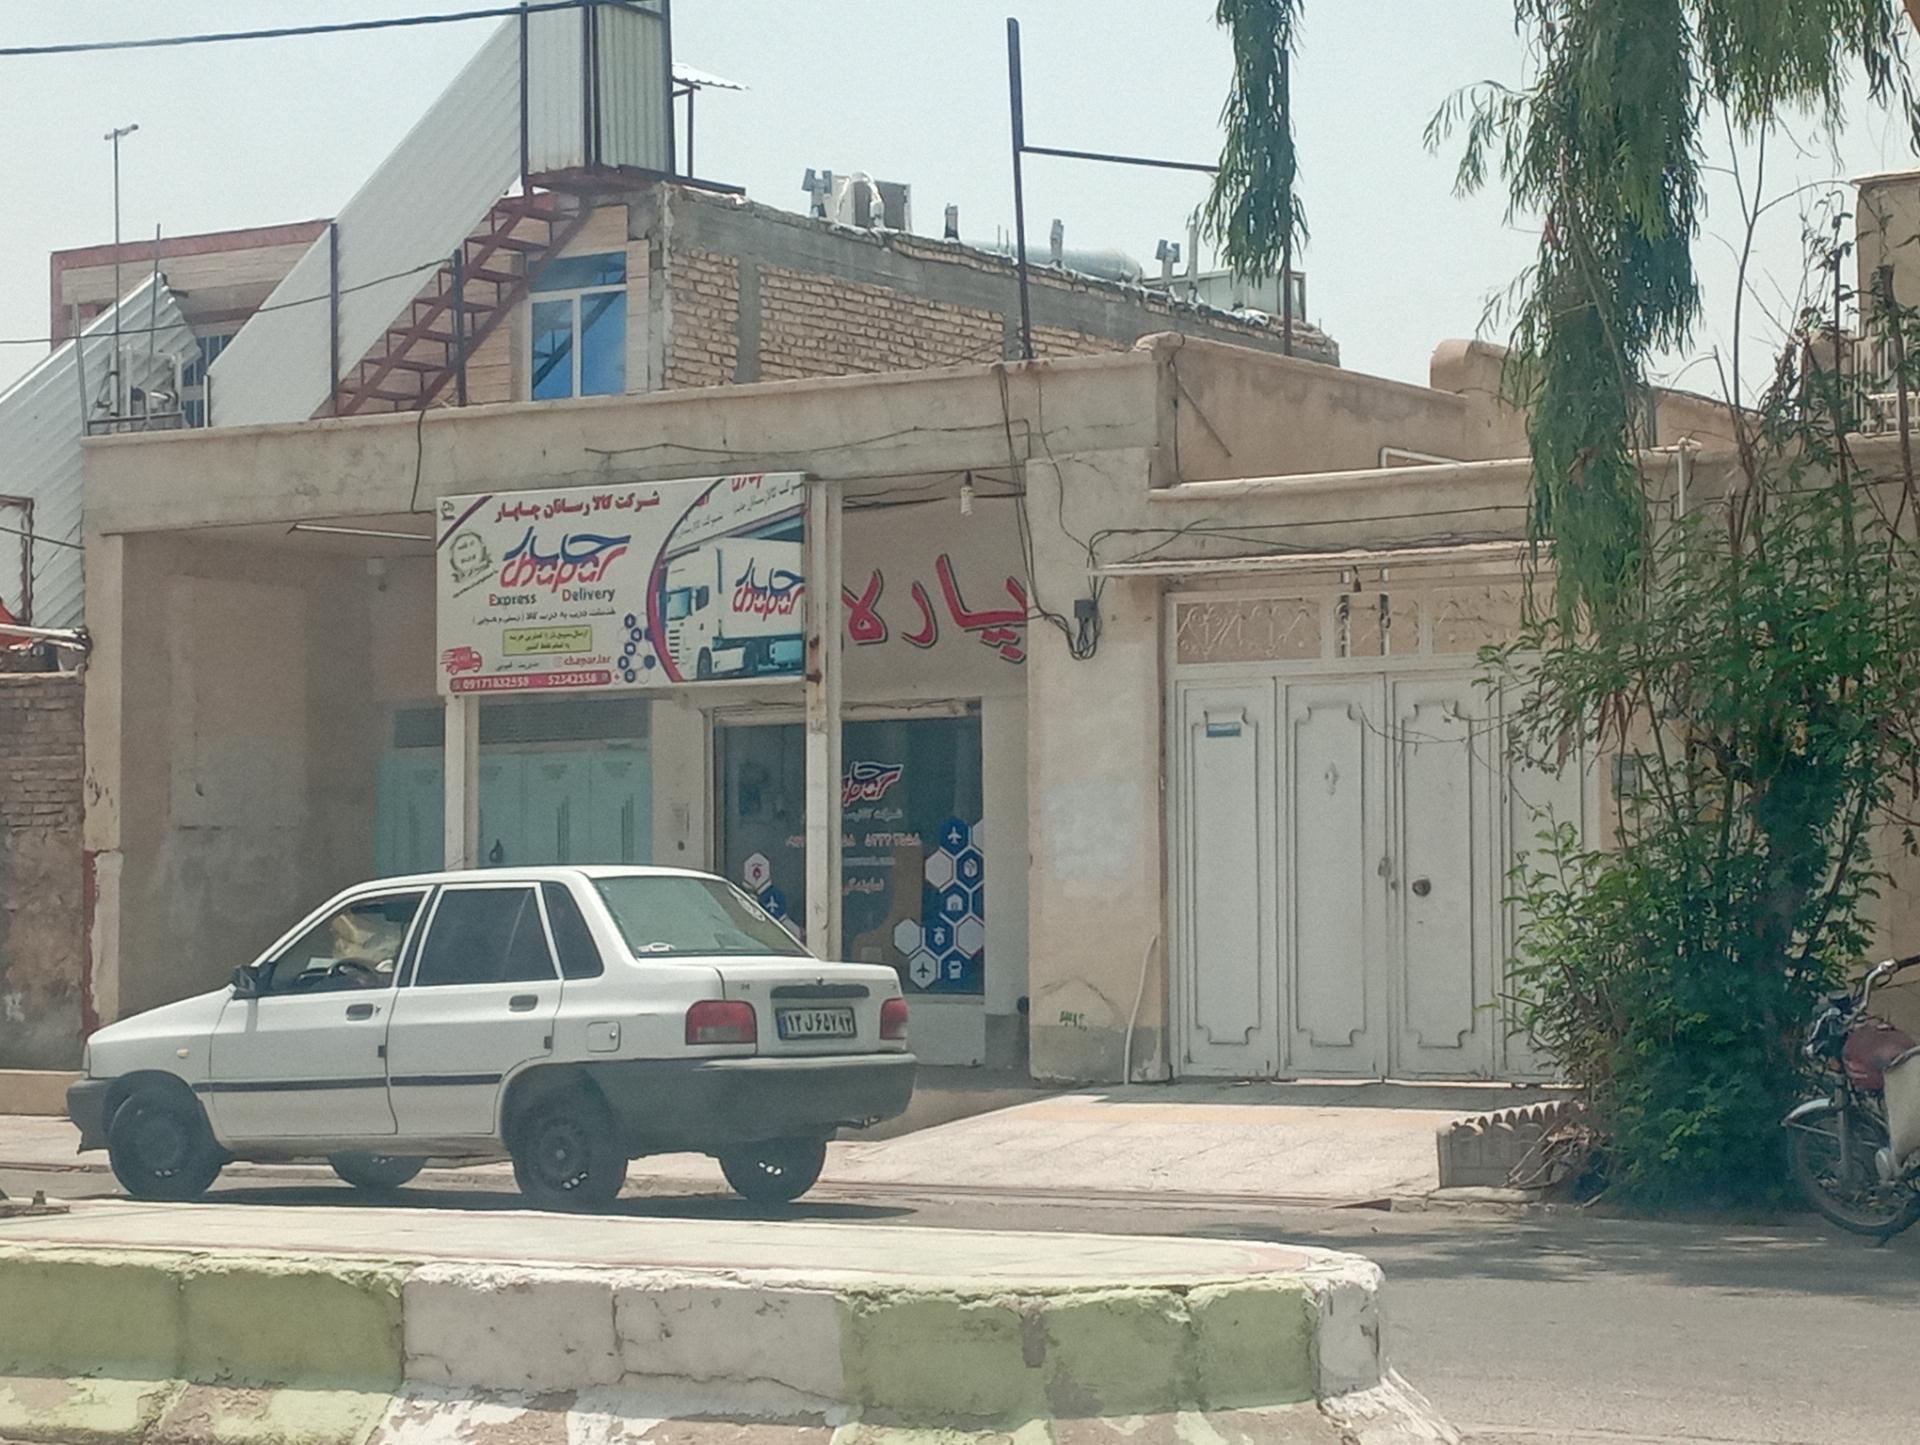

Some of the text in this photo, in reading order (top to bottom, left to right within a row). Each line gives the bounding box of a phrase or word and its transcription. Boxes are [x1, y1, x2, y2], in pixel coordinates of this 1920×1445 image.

[616, 490, 661, 513] شرکت
[488, 588, 616, 608] Express Delivery
